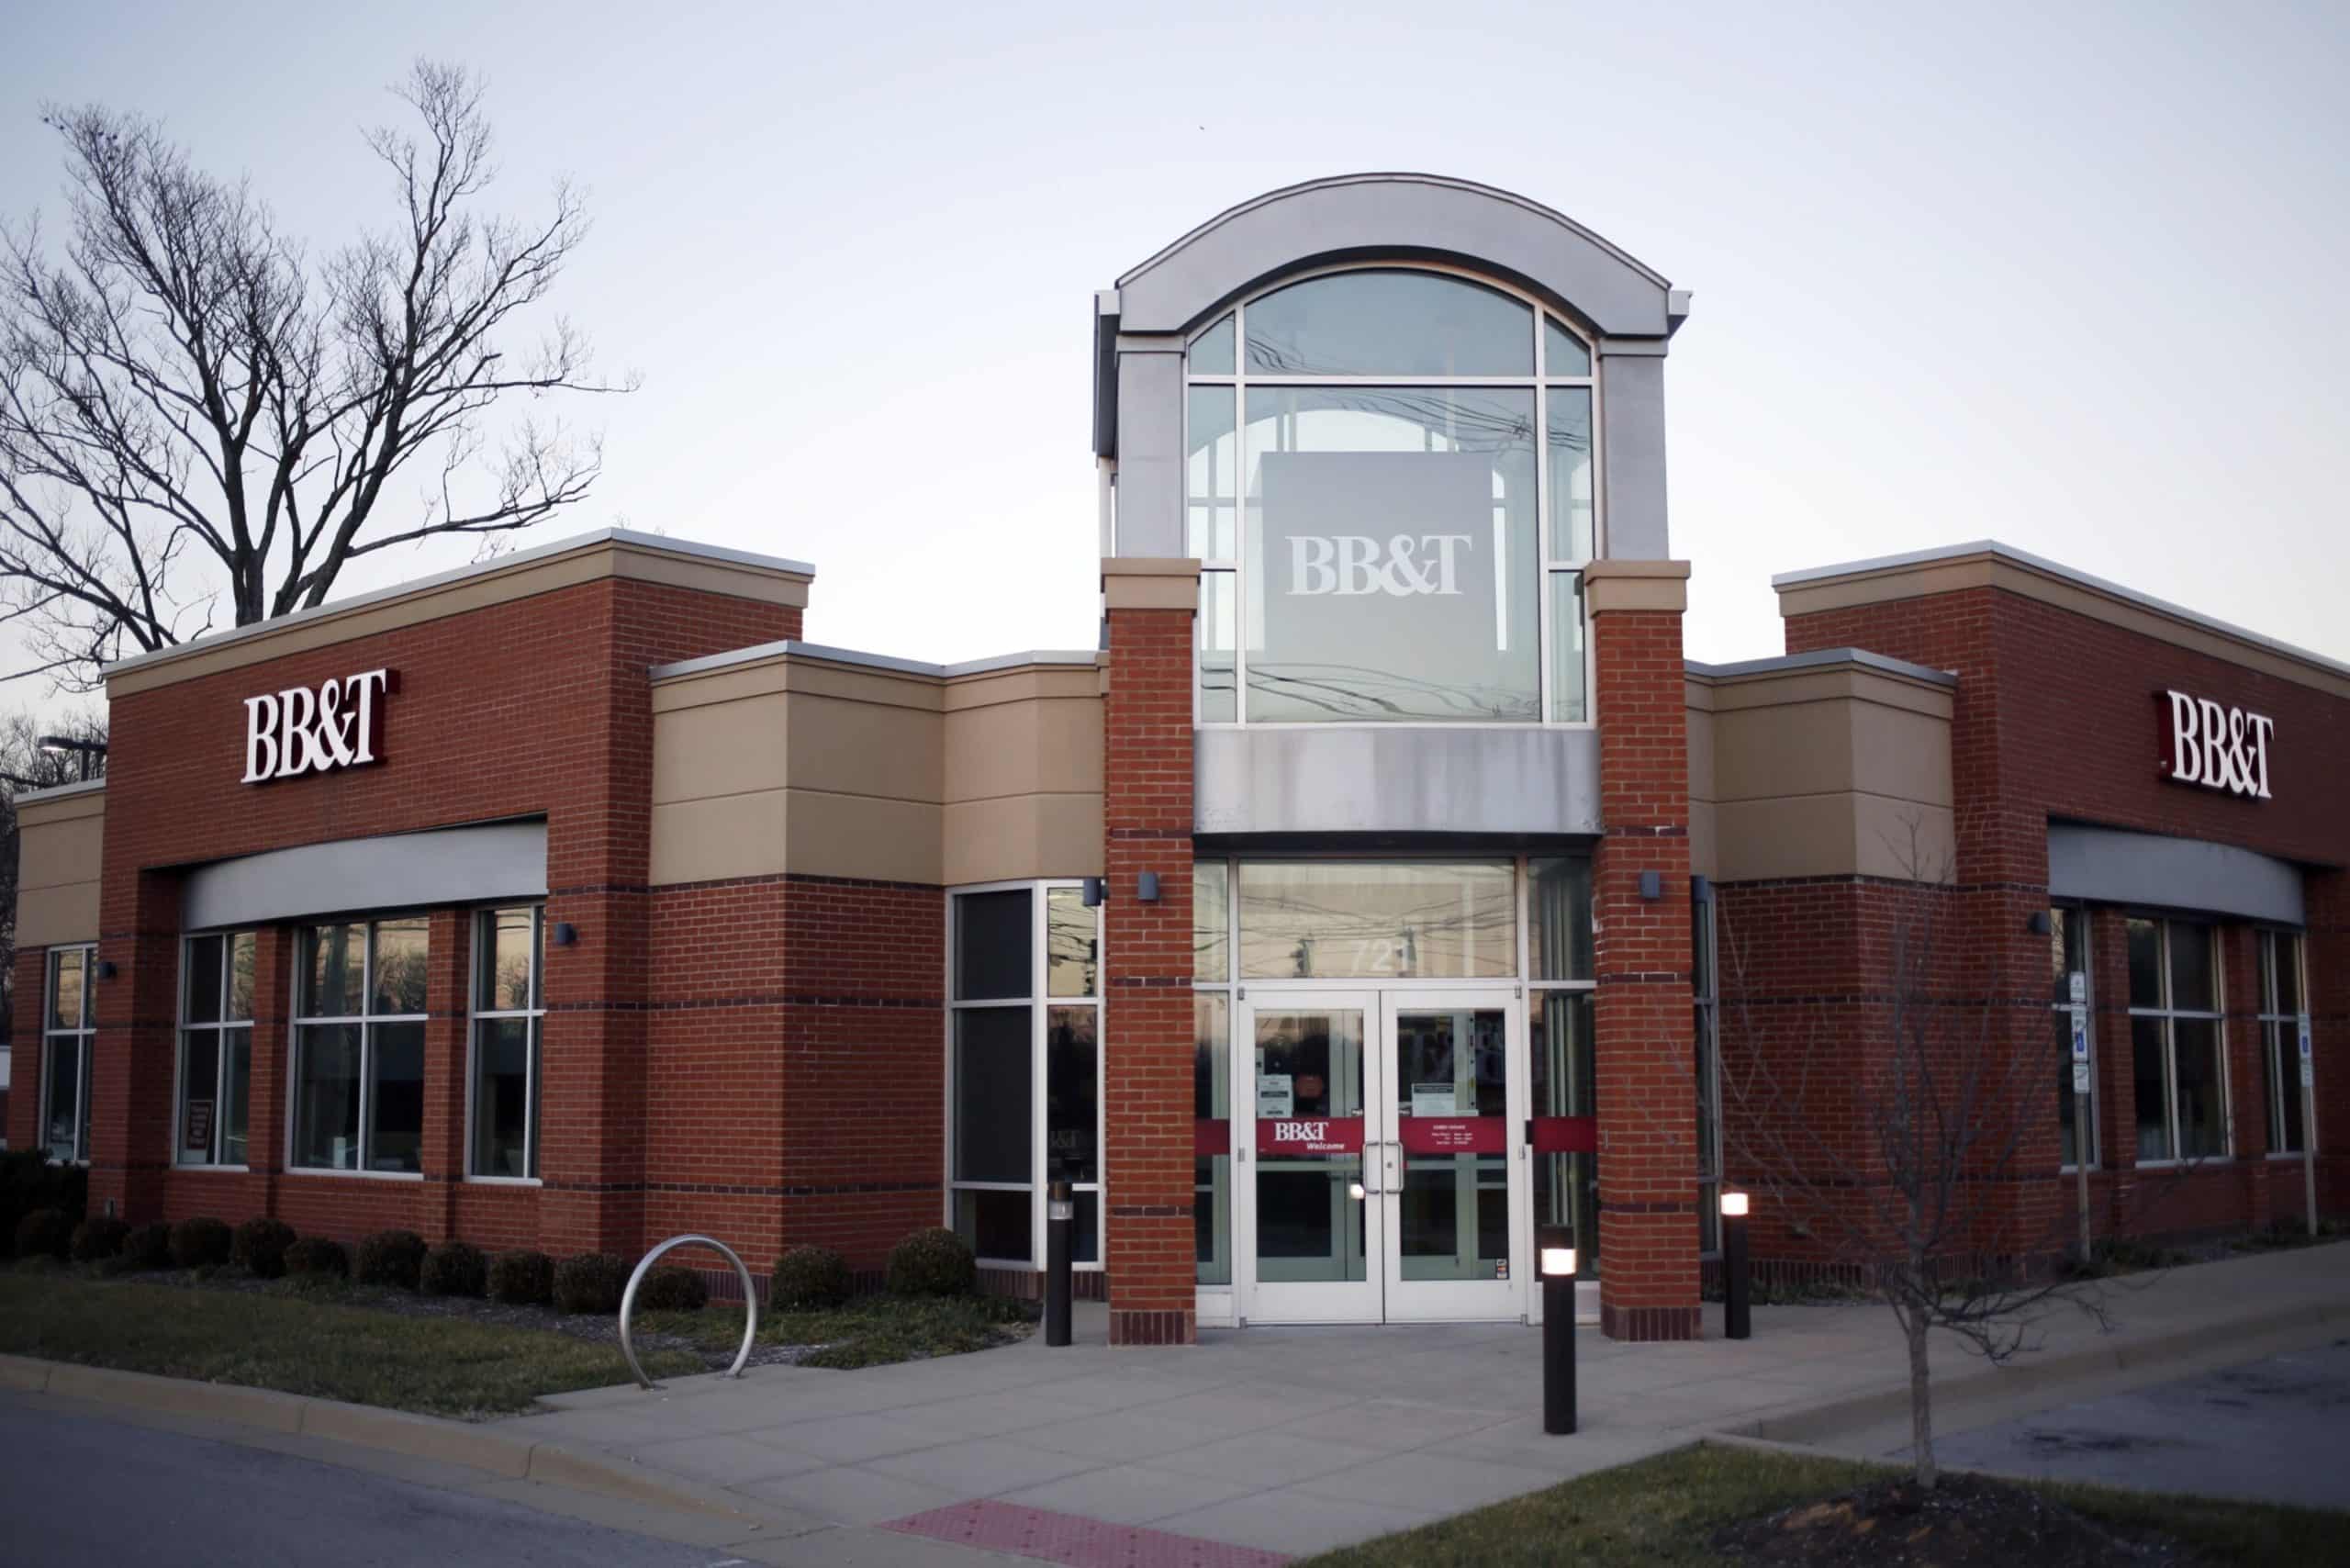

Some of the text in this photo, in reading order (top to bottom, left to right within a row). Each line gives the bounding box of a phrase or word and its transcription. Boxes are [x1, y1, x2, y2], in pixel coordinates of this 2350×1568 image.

[1284, 533, 1472, 597] BB&T
[241, 668, 387, 784] BB&T
[2166, 689, 2276, 800] BB&T
[1273, 1121, 1329, 1142] BB&T
[1306, 1141, 1345, 1151] Welcome
